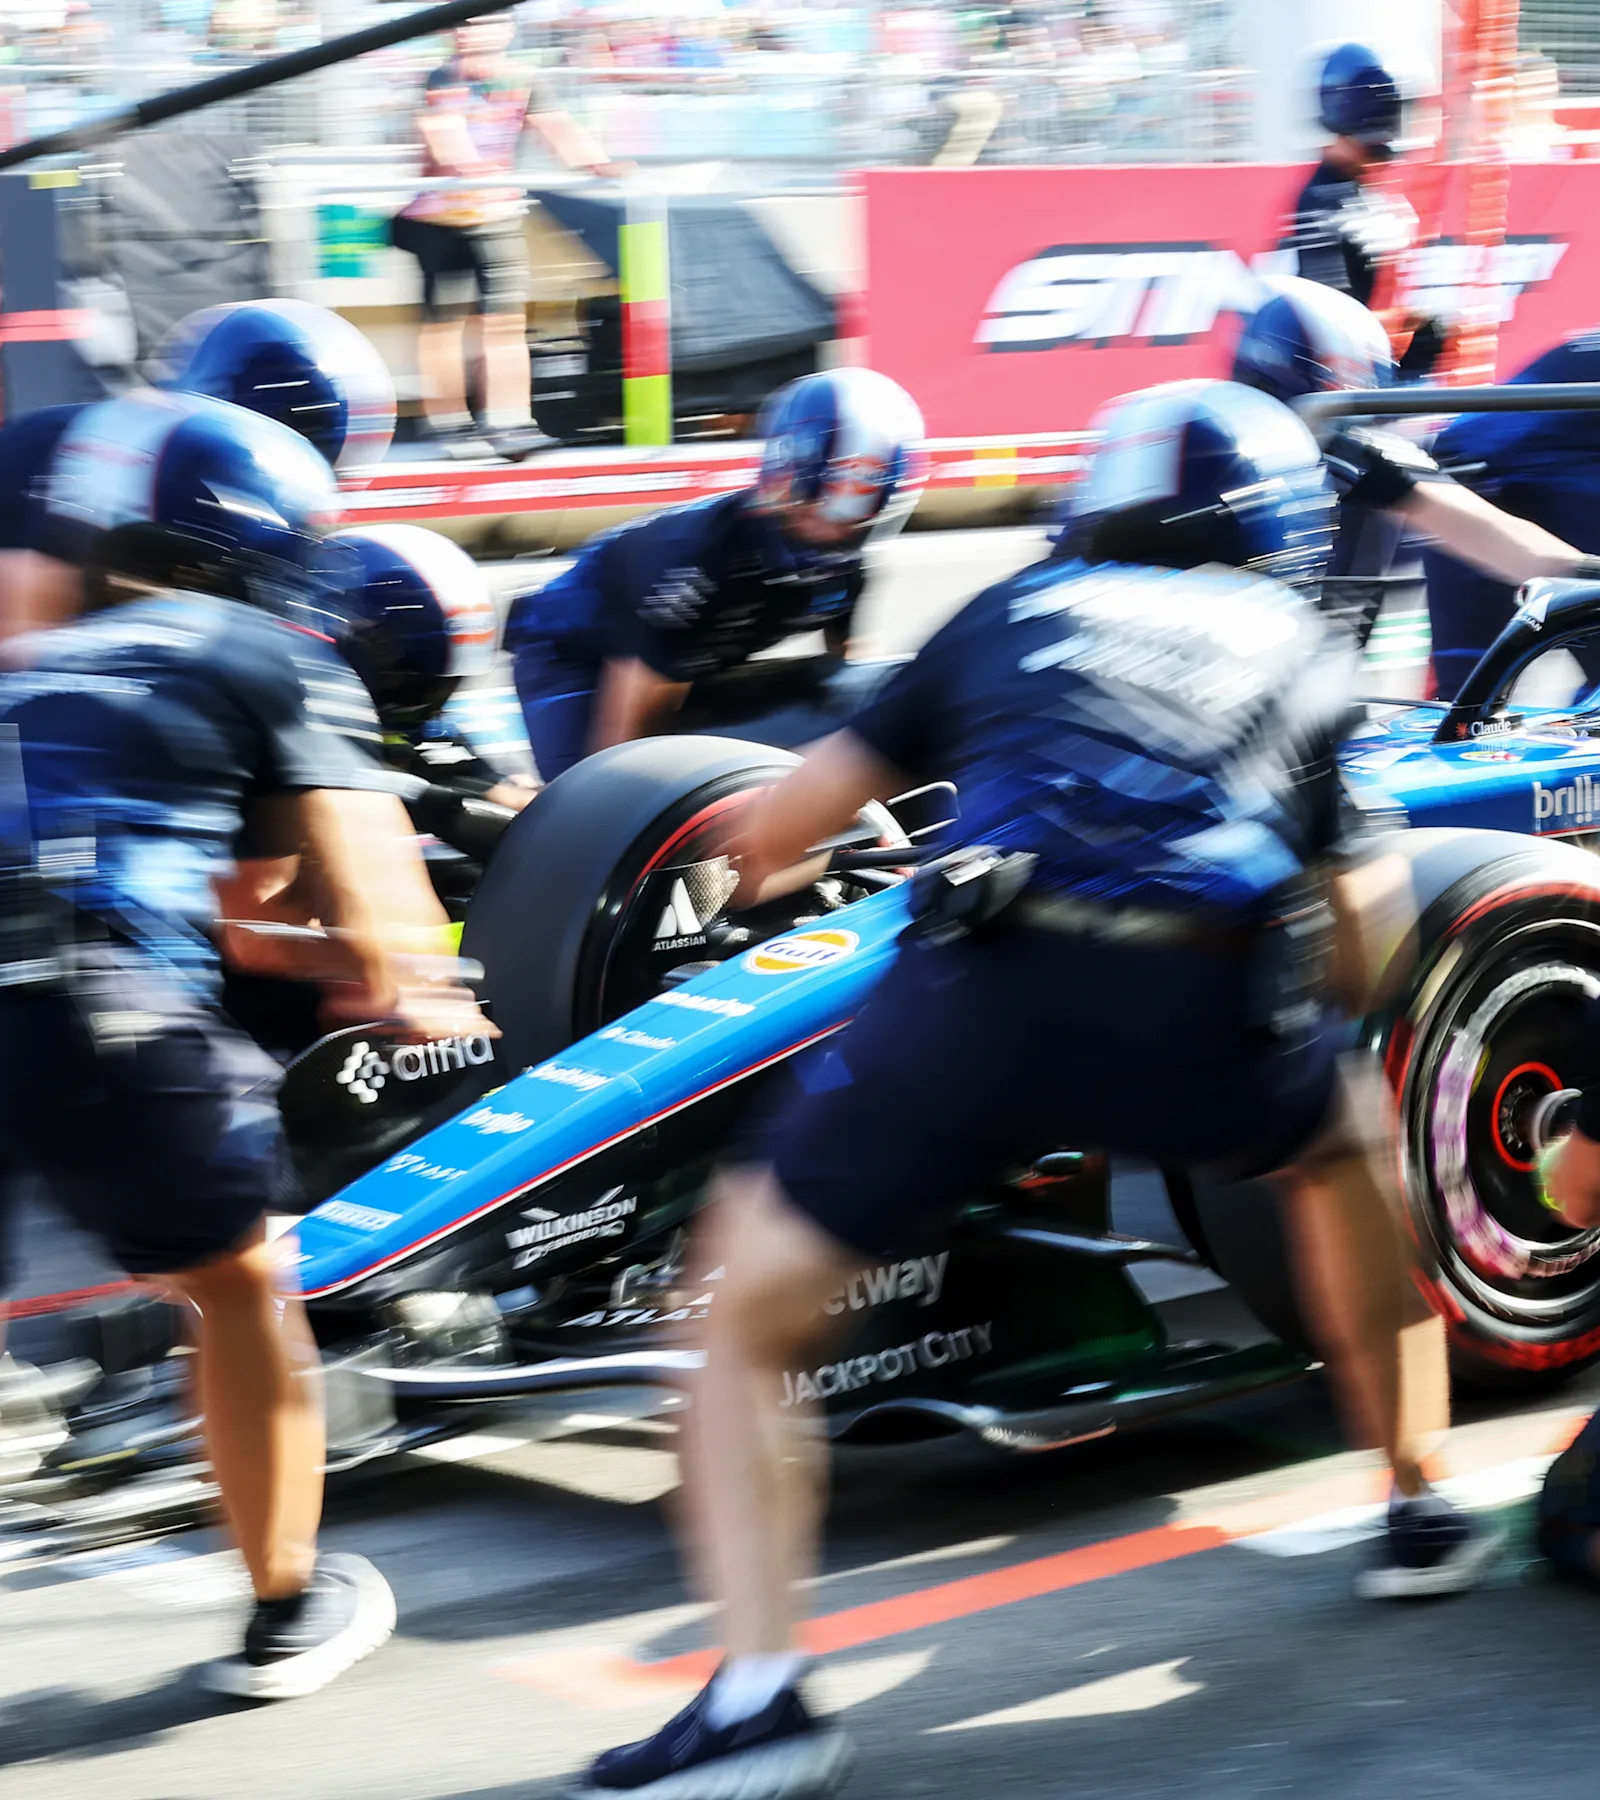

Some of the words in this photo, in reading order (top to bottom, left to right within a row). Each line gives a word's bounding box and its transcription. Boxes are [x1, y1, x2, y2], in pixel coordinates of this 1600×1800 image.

[1471, 718, 1512, 737] Claude
[652, 934, 707, 951] ATLASSIAN
[764, 941, 841, 962] Gulf
[613, 1030, 677, 1049] Claude
[391, 1030, 495, 1082] airia
[505, 1196, 638, 1250] WILKINSON
[822, 1250, 950, 1316] etway
